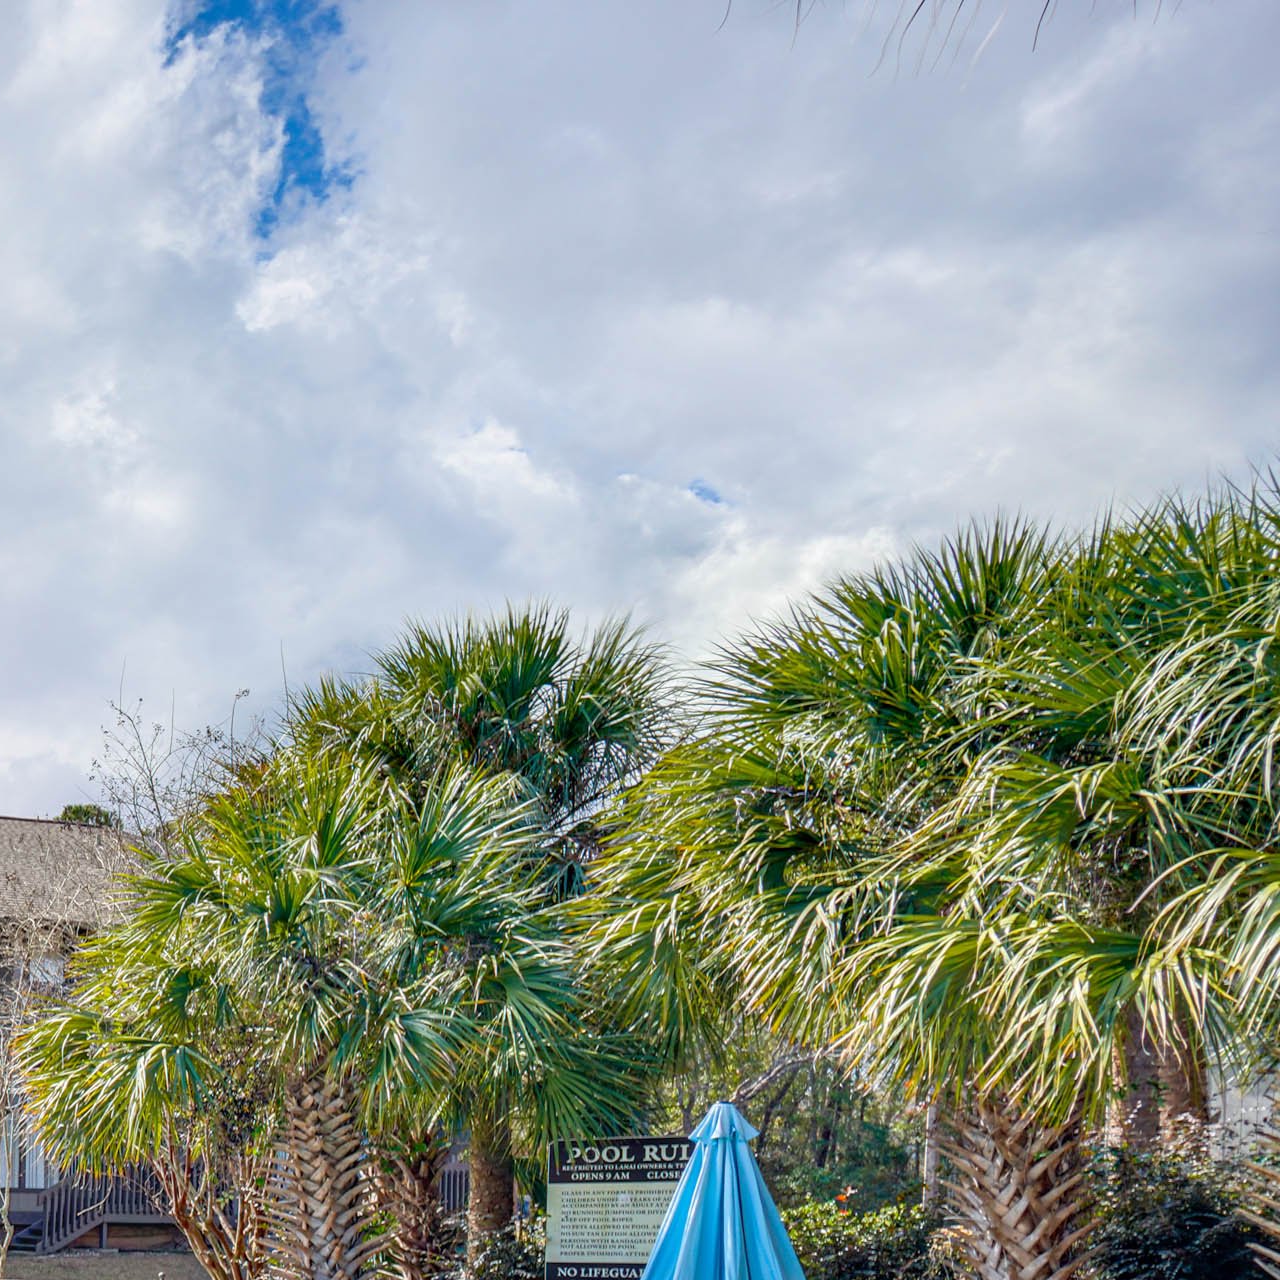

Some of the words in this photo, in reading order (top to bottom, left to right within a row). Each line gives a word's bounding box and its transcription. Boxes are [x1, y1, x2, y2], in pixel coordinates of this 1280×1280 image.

[566, 1145, 635, 1163] POOL
[643, 1143, 689, 1161] RUL
[571, 1172, 604, 1180] OPENS
[605, 1172, 612, 1180] 9
[613, 1171, 630, 1180] AM
[647, 1170, 681, 1179] CLOSE
[557, 1267, 578, 1277] NO
[580, 1267, 643, 1278] LIFEGUA
